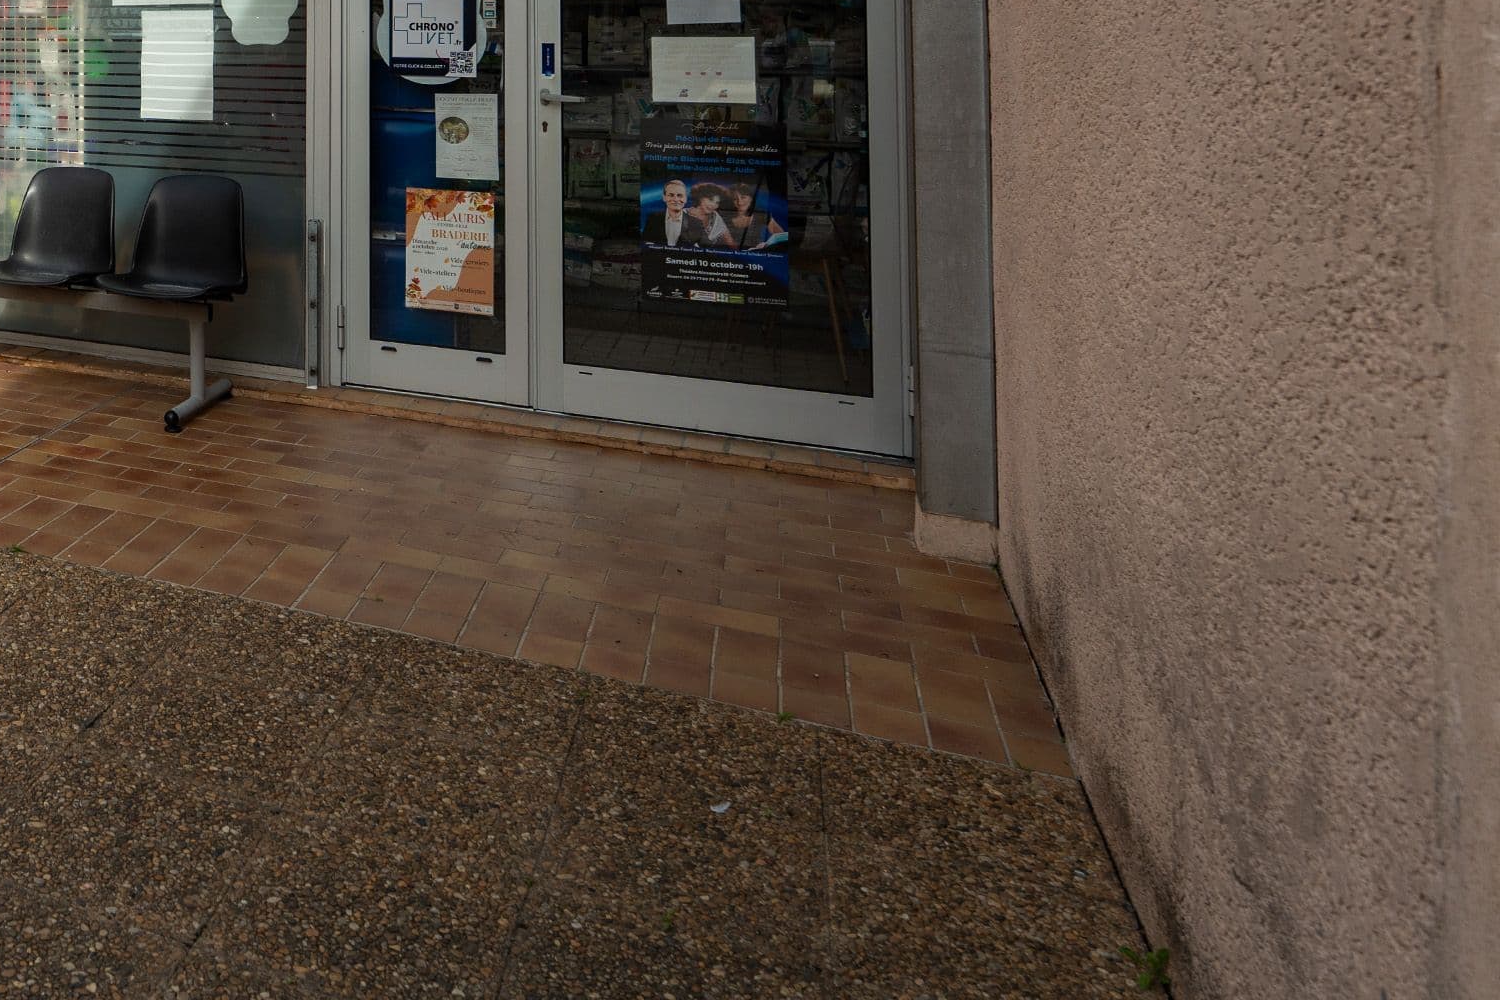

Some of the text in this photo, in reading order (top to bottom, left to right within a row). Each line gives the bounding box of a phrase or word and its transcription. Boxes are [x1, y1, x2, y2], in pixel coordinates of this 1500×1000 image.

[409, 22, 455, 32] CHRONO
[427, 31, 455, 45] VET
[422, 210, 486, 225] VALLAURIS
[431, 228, 489, 242] BRADERIE
[665, 257, 697, 266] Samedi
[699, 259, 708, 267] 10
[710, 260, 744, 270] octobre
